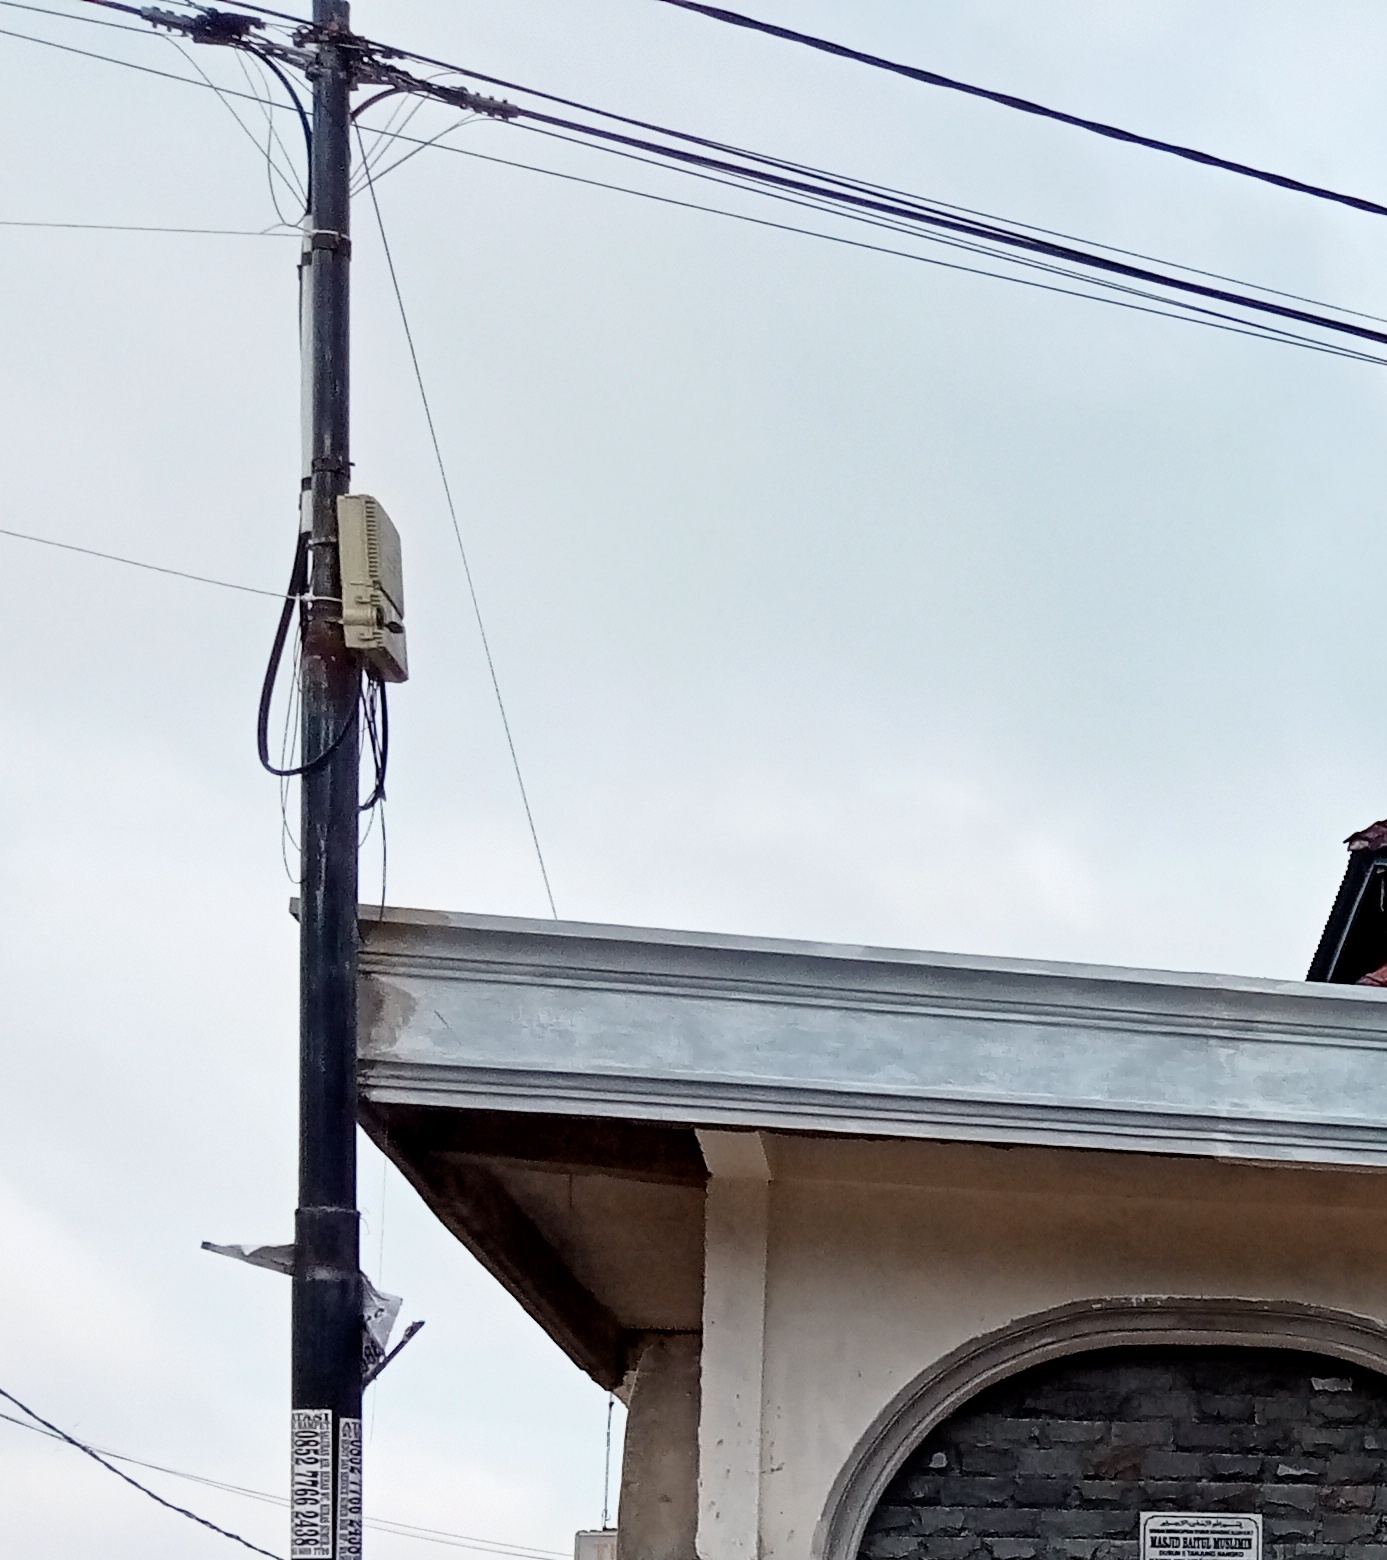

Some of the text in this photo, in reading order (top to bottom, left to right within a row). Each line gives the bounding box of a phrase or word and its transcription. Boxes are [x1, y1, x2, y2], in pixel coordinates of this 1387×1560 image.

[294, 1430, 320, 1466] 0852
[294, 1470, 320, 1506] 7766
[294, 1511, 320, 1547] 2438
[1150, 1536, 1180, 1549] MASJID
[1182, 1537, 1212, 1549] BAITUL
